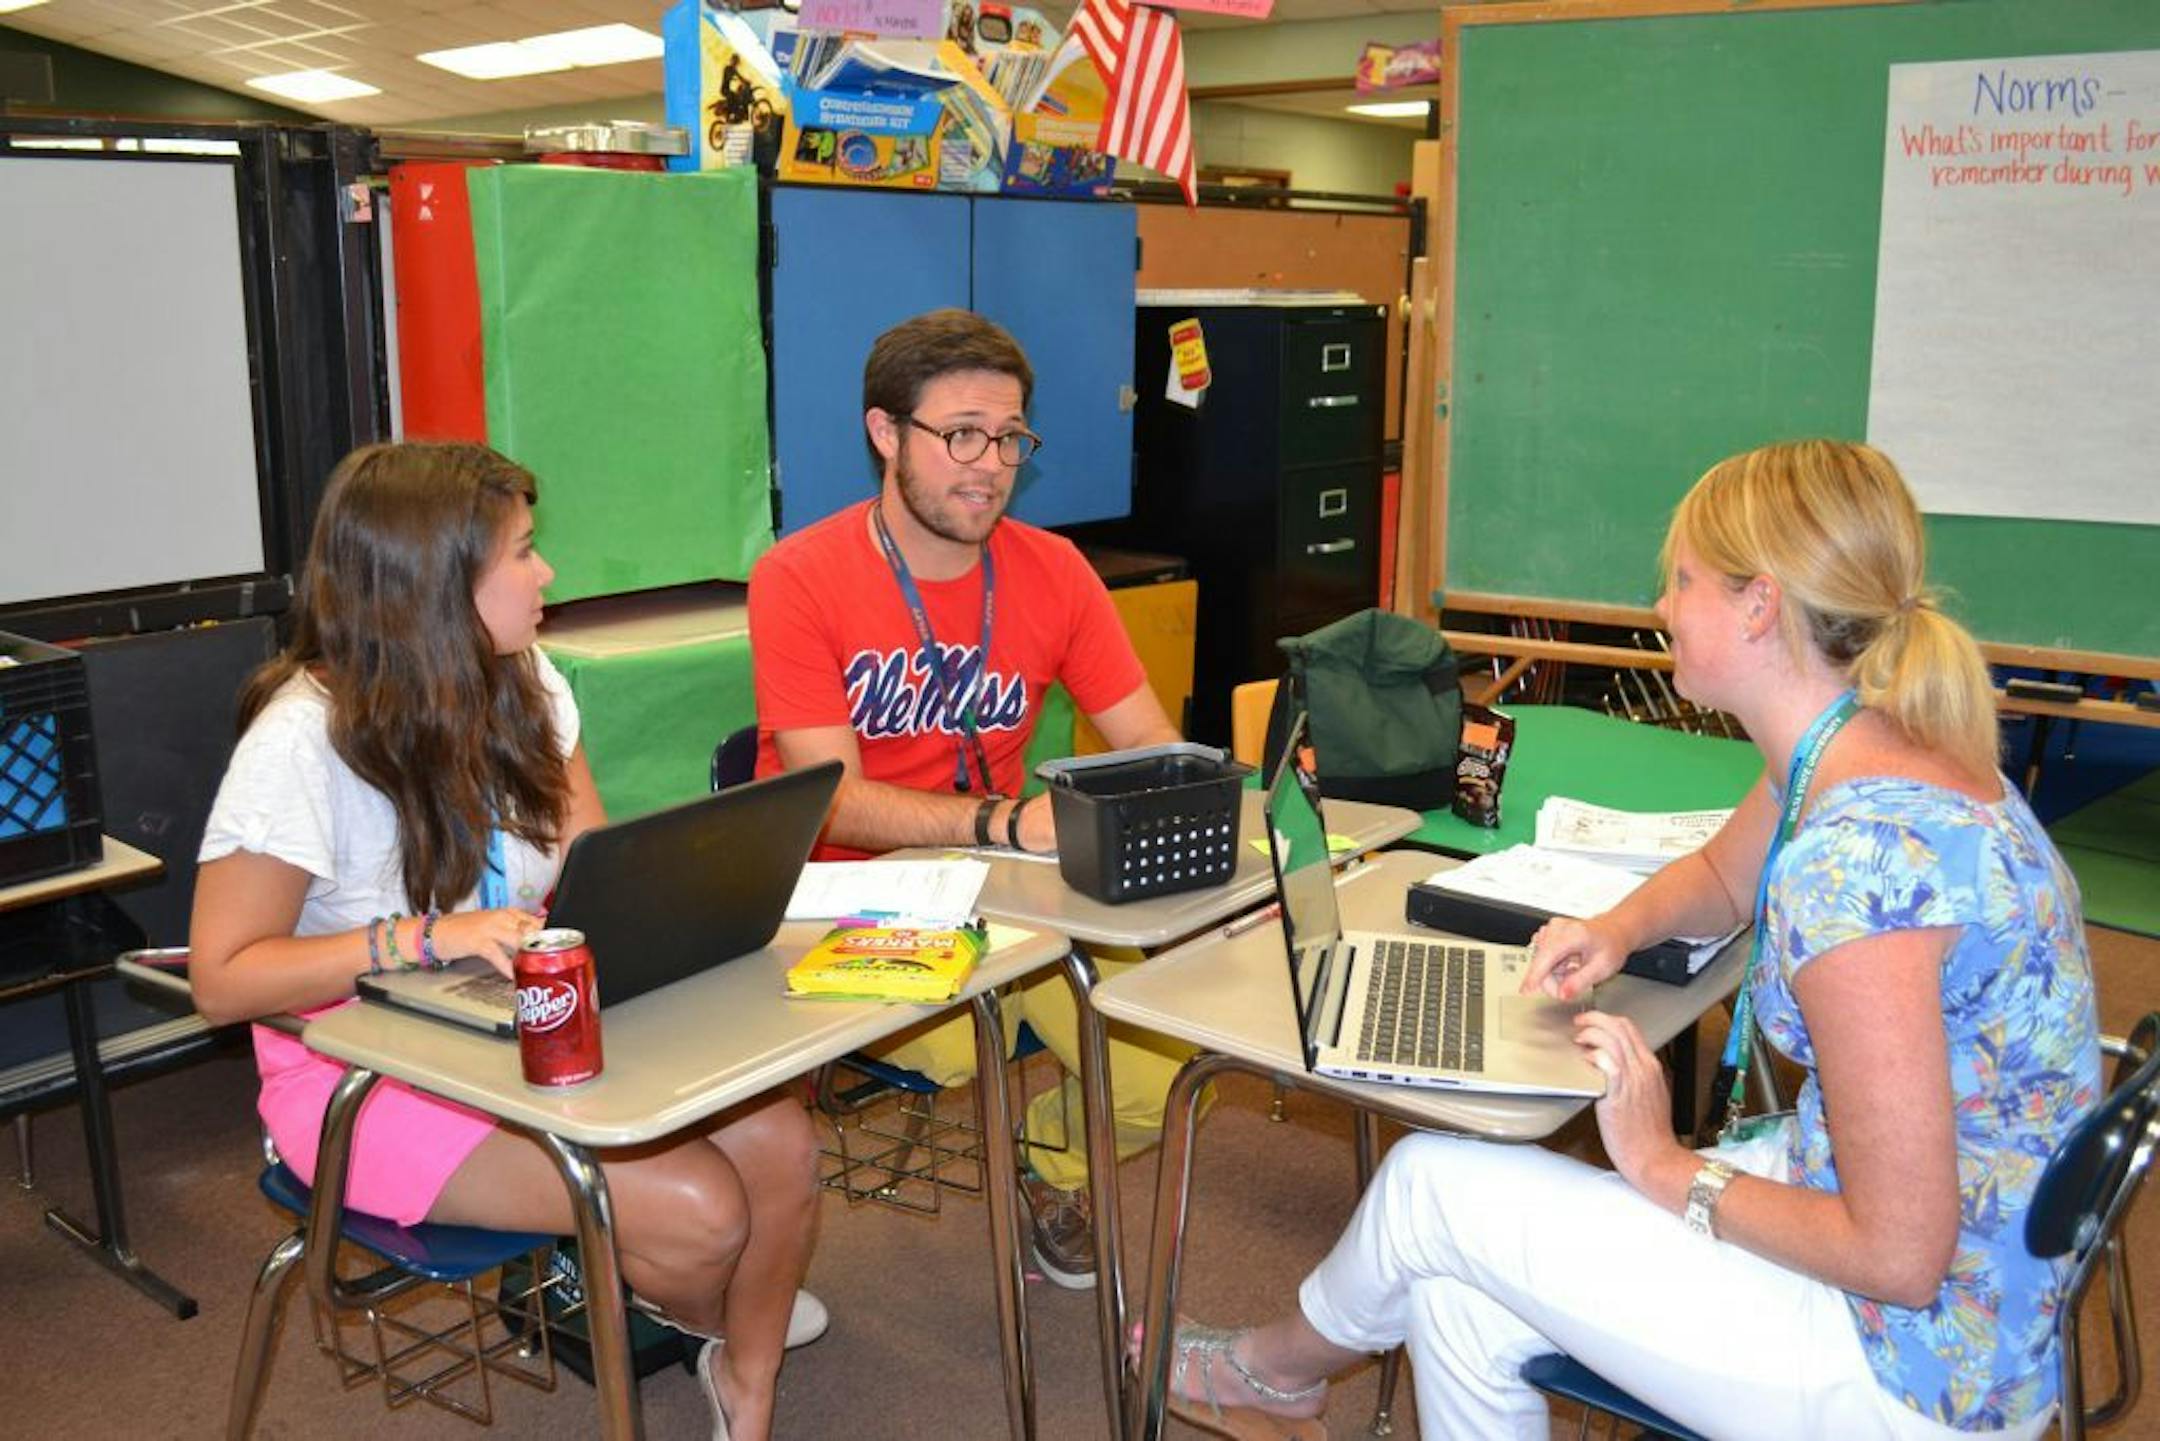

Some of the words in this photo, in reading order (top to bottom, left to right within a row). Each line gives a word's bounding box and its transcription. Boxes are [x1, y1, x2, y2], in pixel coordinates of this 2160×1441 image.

[1902, 124, 1983, 157] What's
[1990, 122, 2112, 160] important
[1930, 160, 2048, 188] remember
[2053, 157, 2133, 198] during
[844, 647, 918, 739] Ole
